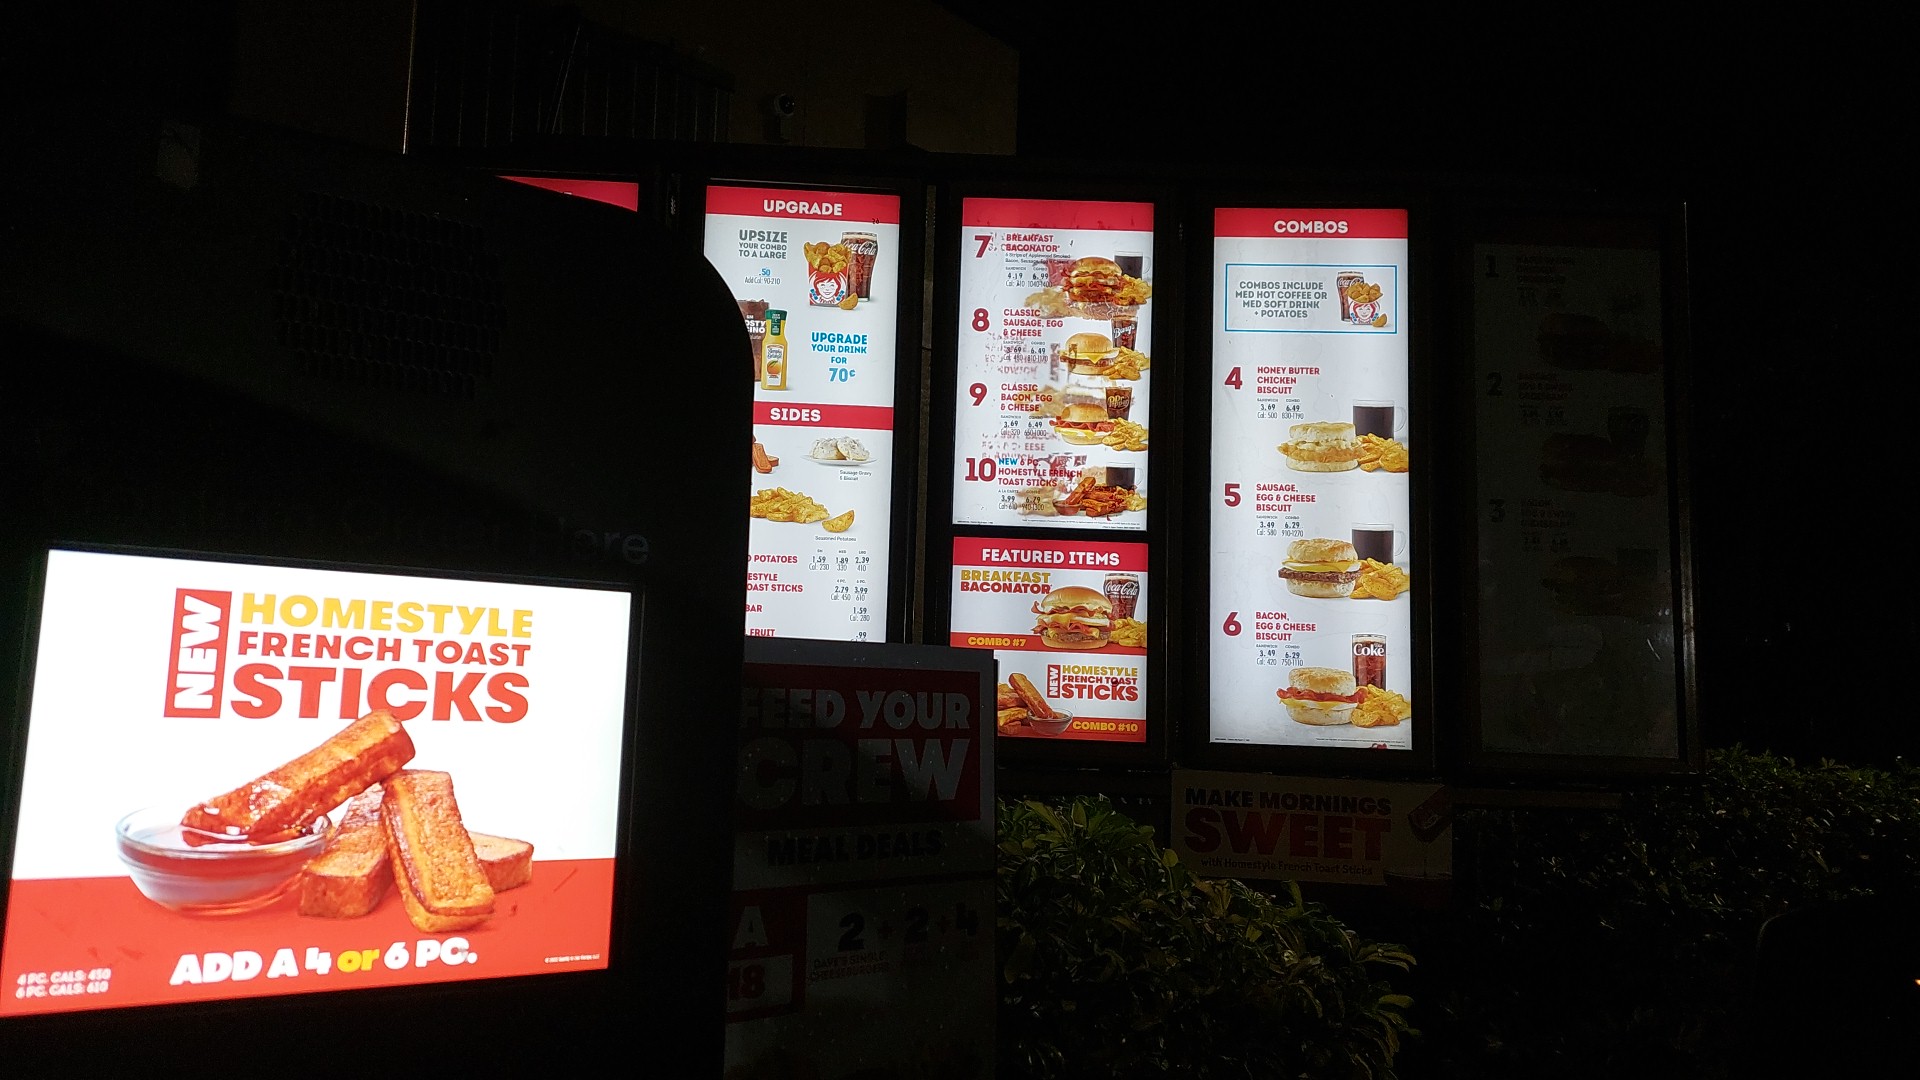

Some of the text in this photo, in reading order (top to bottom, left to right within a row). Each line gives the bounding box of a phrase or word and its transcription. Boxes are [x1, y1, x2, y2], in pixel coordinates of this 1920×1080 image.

[764, 200, 842, 216] UPGRADE
[1274, 221, 1349, 233] COMBOS
[739, 230, 788, 243] UPSIZE
[1006, 234, 1054, 242] BREAKFAST
[760, 243, 787, 251] COMBO
[974, 236, 991, 258] 7
[759, 251, 787, 259] LARGE
[1485, 255, 1499, 278] 1
[1239, 282, 1324, 290] COMBOS INCLUDE
[1235, 291, 1327, 300] MED HOT COFFEE OR
[1243, 300, 1320, 309] MED SOFT DRINK
[972, 308, 990, 331] 8
[1261, 310, 1308, 318] POTATOES
[1004, 319, 1044, 327] SAUSAGE,
[812, 332, 867, 345] UPGRADE
[812, 345, 867, 354] YOUR DRINK
[1257, 367, 1320, 375] HONEY BUTTER
[1225, 367, 1243, 390] 4
[1487, 372, 1503, 396] 2
[969, 383, 987, 406] 9
[1257, 386, 1292, 394] BISCUIT
[1036, 394, 1053, 402] EGG
[770, 408, 821, 422] SIDES
[965, 458, 996, 481] 10
[1256, 484, 1299, 493] SAUSAGE,
[1224, 484, 1241, 507] 5
[1256, 494, 1316, 503] EGG & CHEESE
[1256, 504, 1292, 512] BISCUIT
[1489, 499, 1505, 523] 3
[754, 555, 798, 564] POTATOES
[982, 549, 1120, 566] FEATURED ITEMS
[748, 573, 778, 581] ESTYLE
[961, 570, 1050, 583] BREAKFAST
[771, 584, 803, 592] STICKS
[241, 592, 533, 638] HOMESTYLE
[1256, 612, 1290, 621] BACON,
[1223, 612, 1242, 637] 6
[1256, 622, 1316, 632] EGG & CHEESE
[968, 637, 1026, 647] COMBO #7
[1256, 633, 1292, 641] BISCUIT
[174, 596, 221, 711] NEW
[238, 631, 531, 667] FRENCH TOAST
[1354, 643, 1384, 656] Coke
[1063, 665, 1138, 676] HOMESTYLE
[1049, 667, 1059, 696] NEW
[1105, 677, 1137, 685] TOAST
[230, 664, 530, 724] STICKS
[1062, 683, 1139, 701] STICKS
[855, 691, 971, 729] YOUR
[1073, 722, 1138, 732] COMBO #10
[738, 737, 970, 809] CREW
[1185, 788, 1392, 815] MAKE MORNINGS
[1184, 808, 1391, 861] SWEET
[768, 830, 945, 866] MEAL DEALS
[1201, 858, 1373, 876] with Homestyle French Toast Sticks
[732, 905, 769, 950] A
[838, 902, 979, 951] 2 2 4
[170, 937, 478, 985] ADD A 4 or 6 PC.
[17, 974, 26, 985] 4
[27, 973, 49, 985] PC.
[88, 968, 112, 980] 450
[16, 987, 25, 999] 6
[26, 986, 47, 997] PC.
[87, 981, 109, 993] 610
